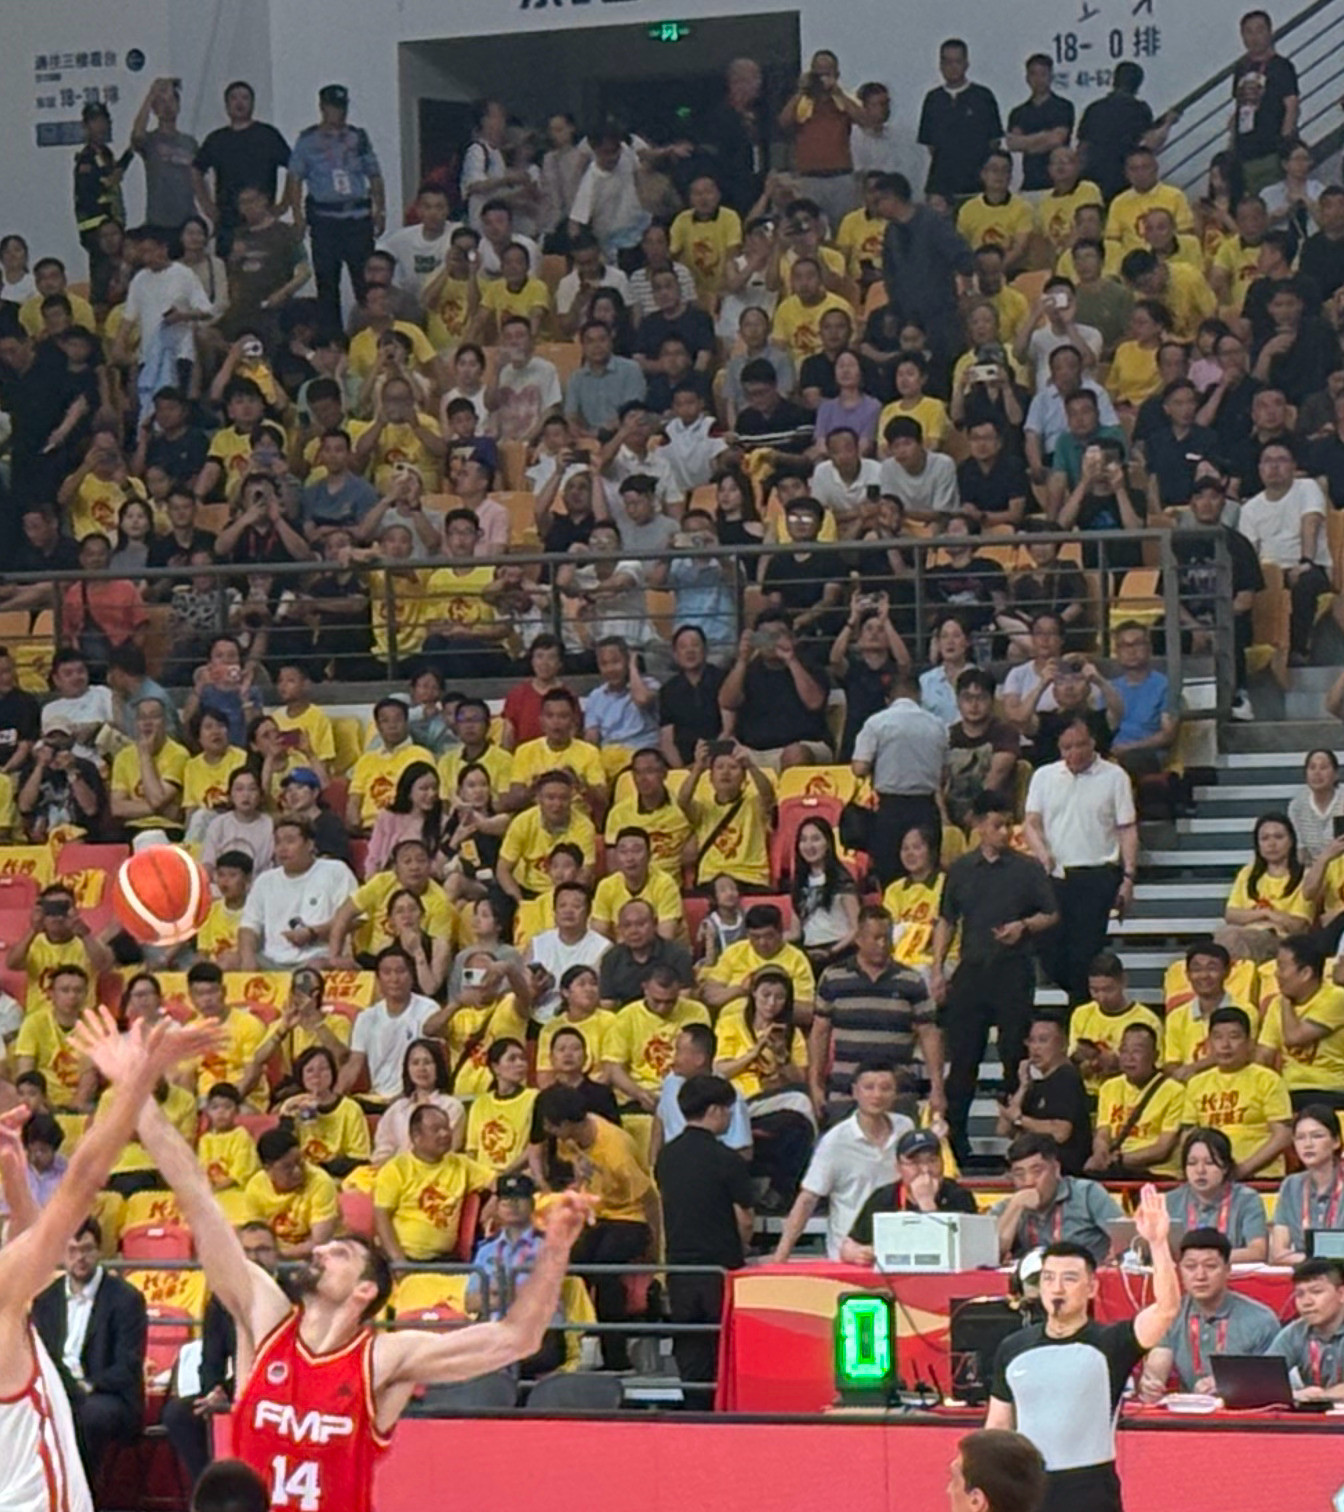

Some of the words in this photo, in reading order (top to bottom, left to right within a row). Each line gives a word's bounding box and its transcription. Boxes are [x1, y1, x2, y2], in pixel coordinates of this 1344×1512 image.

[1199, 1089, 1239, 1113] 长沙
[841, 1298, 891, 1379] 0
[254, 1399, 354, 1444] FMP
[271, 1454, 322, 1512] 14
